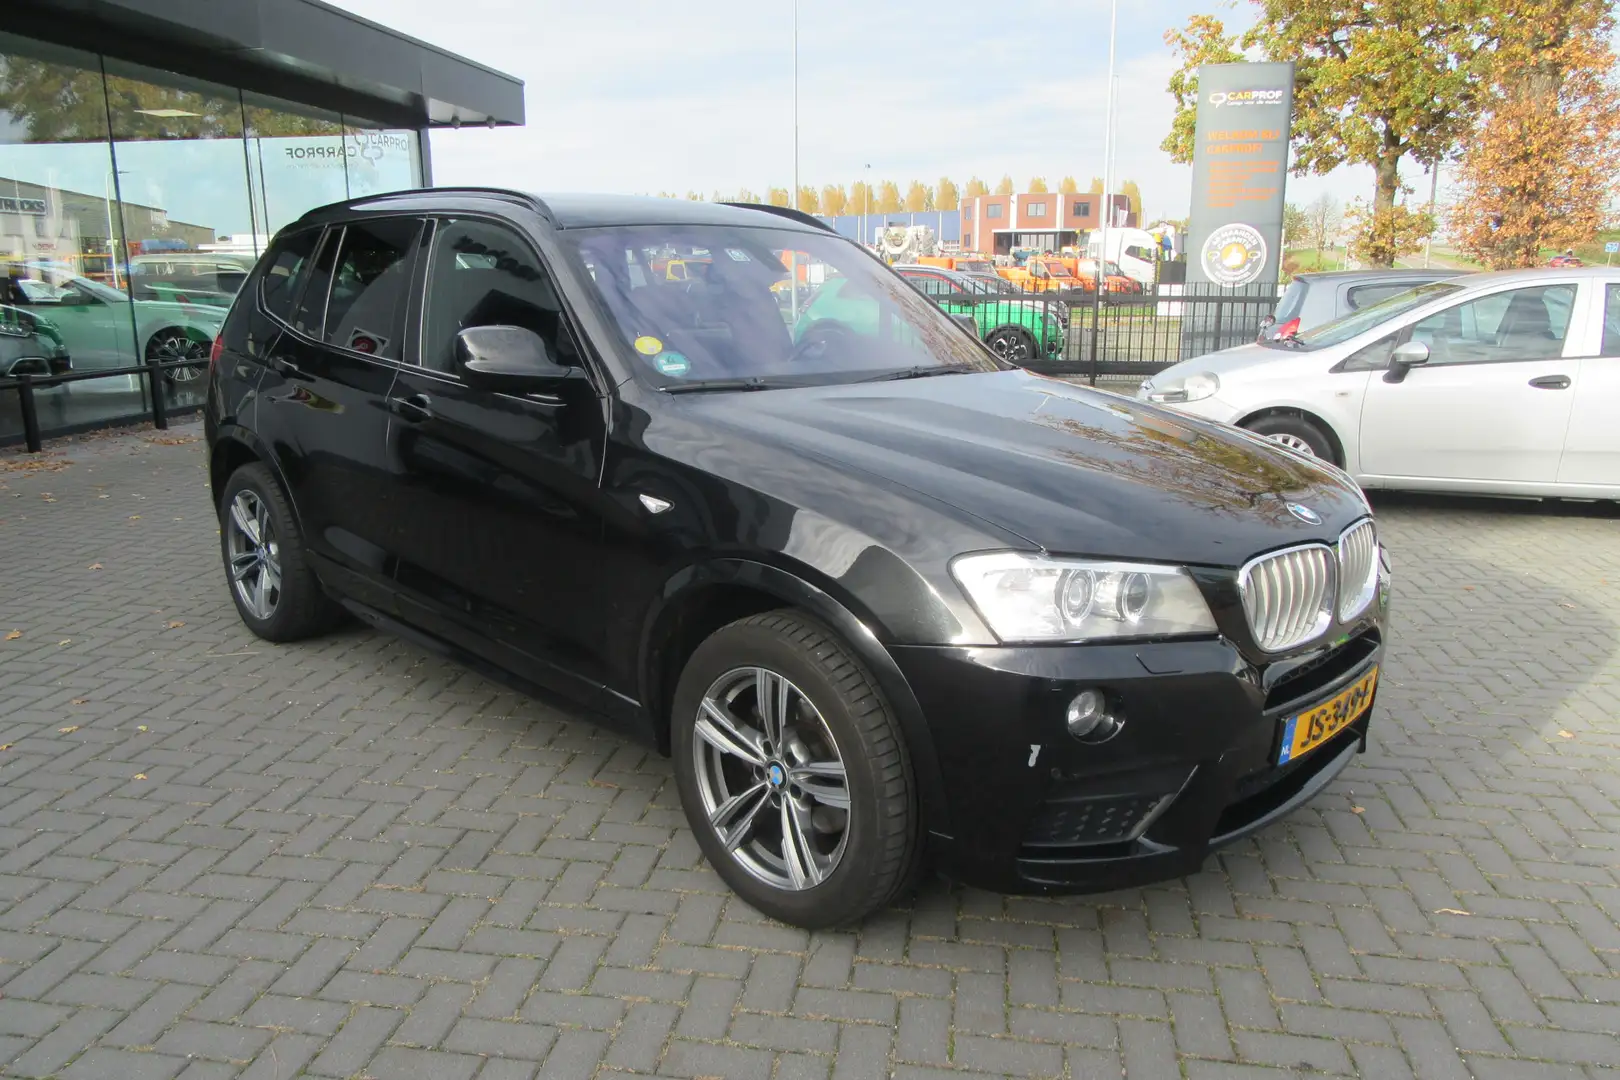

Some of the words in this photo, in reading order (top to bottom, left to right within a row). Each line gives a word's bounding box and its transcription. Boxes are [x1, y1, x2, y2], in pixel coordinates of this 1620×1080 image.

[1227, 90, 1283, 101] CARPROF
[371, 133, 409, 151] CARPRO
[1281, 745, 1290, 756] NL
